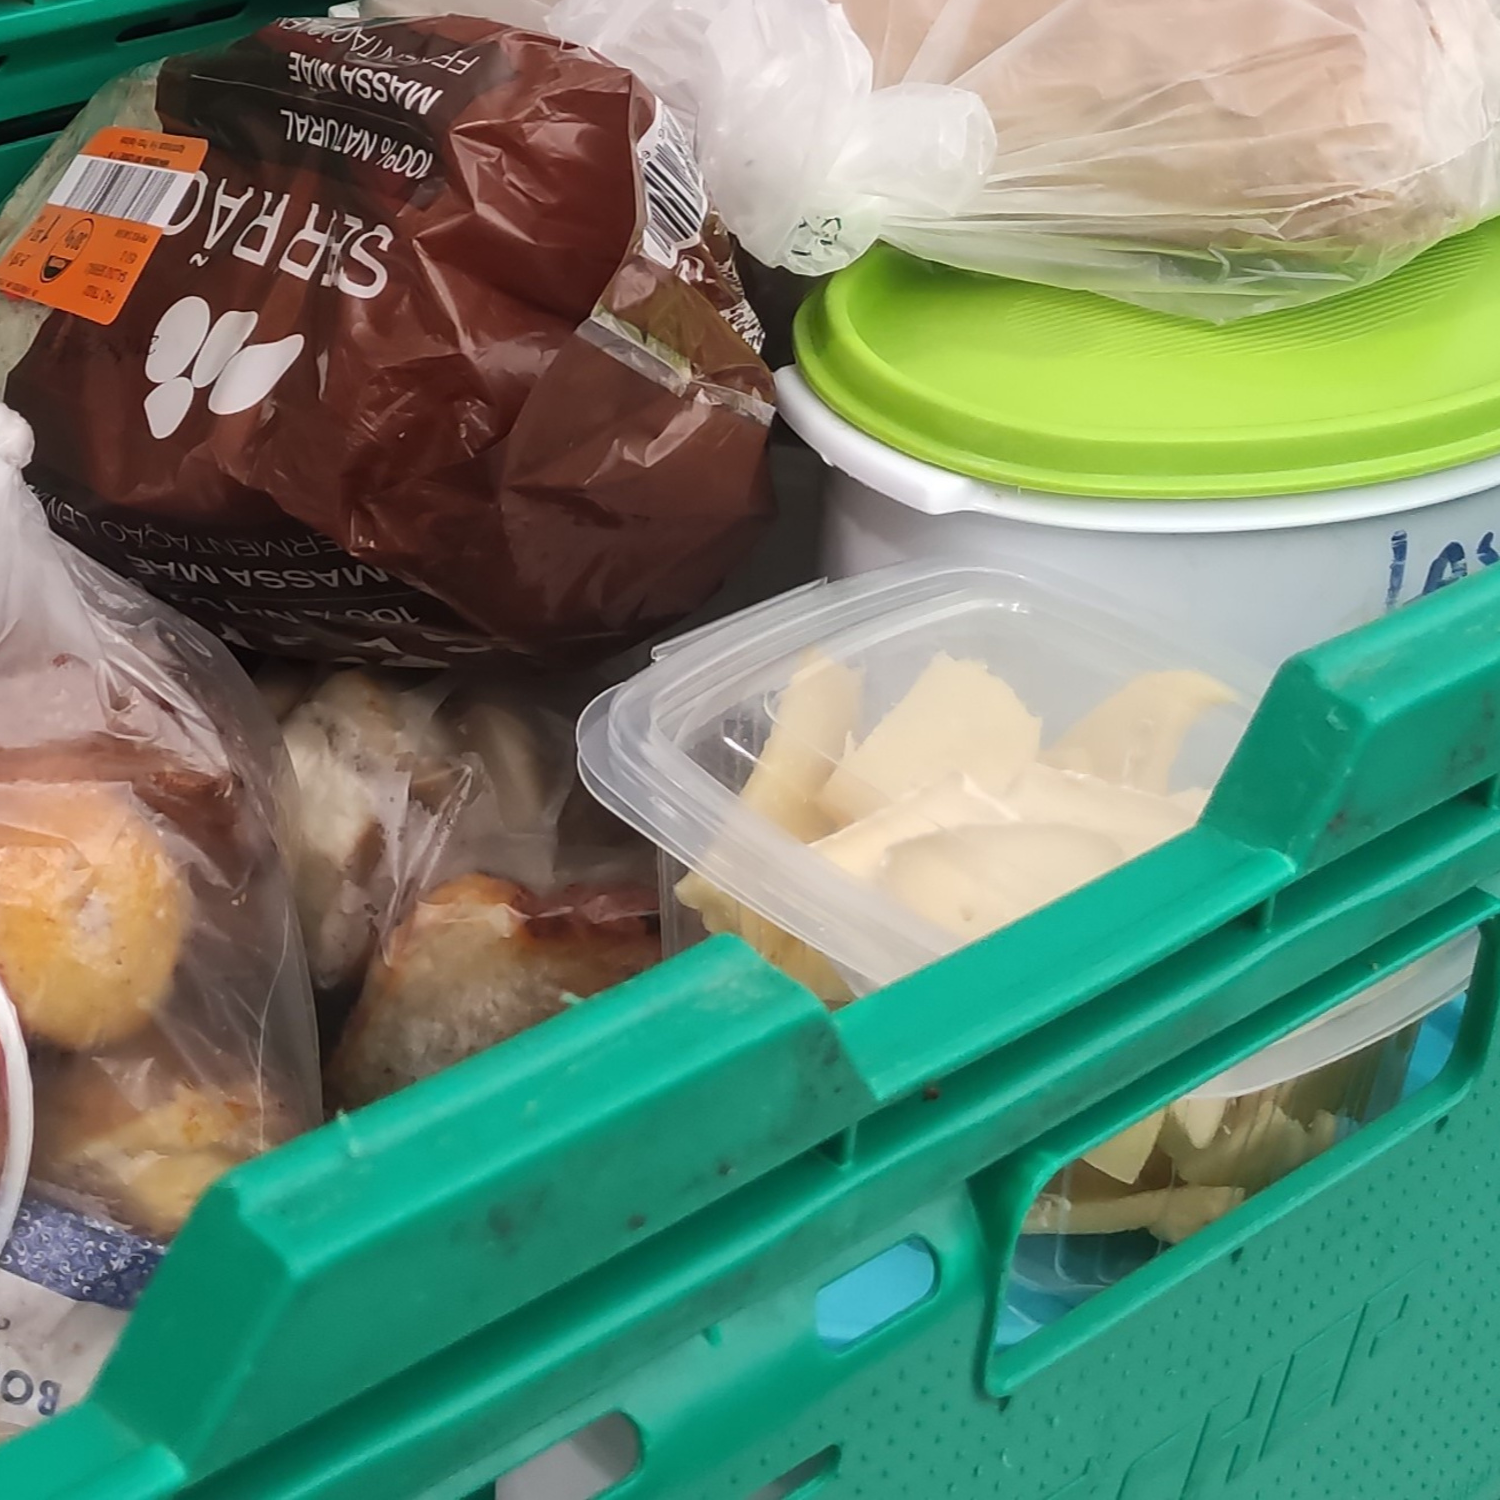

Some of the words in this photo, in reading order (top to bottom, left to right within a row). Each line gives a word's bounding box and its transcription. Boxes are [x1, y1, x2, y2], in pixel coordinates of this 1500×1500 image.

[285, 50, 335, 90] MÃE
[341, 64, 442, 113] MASSA
[279, 108, 377, 160] NATURAL
[374, 136, 433, 179] 100%
[100, 519, 338, 556] ERMENTAÇÃO
[123, 552, 221, 583] MÃE
[226, 563, 388, 590] MASSA
